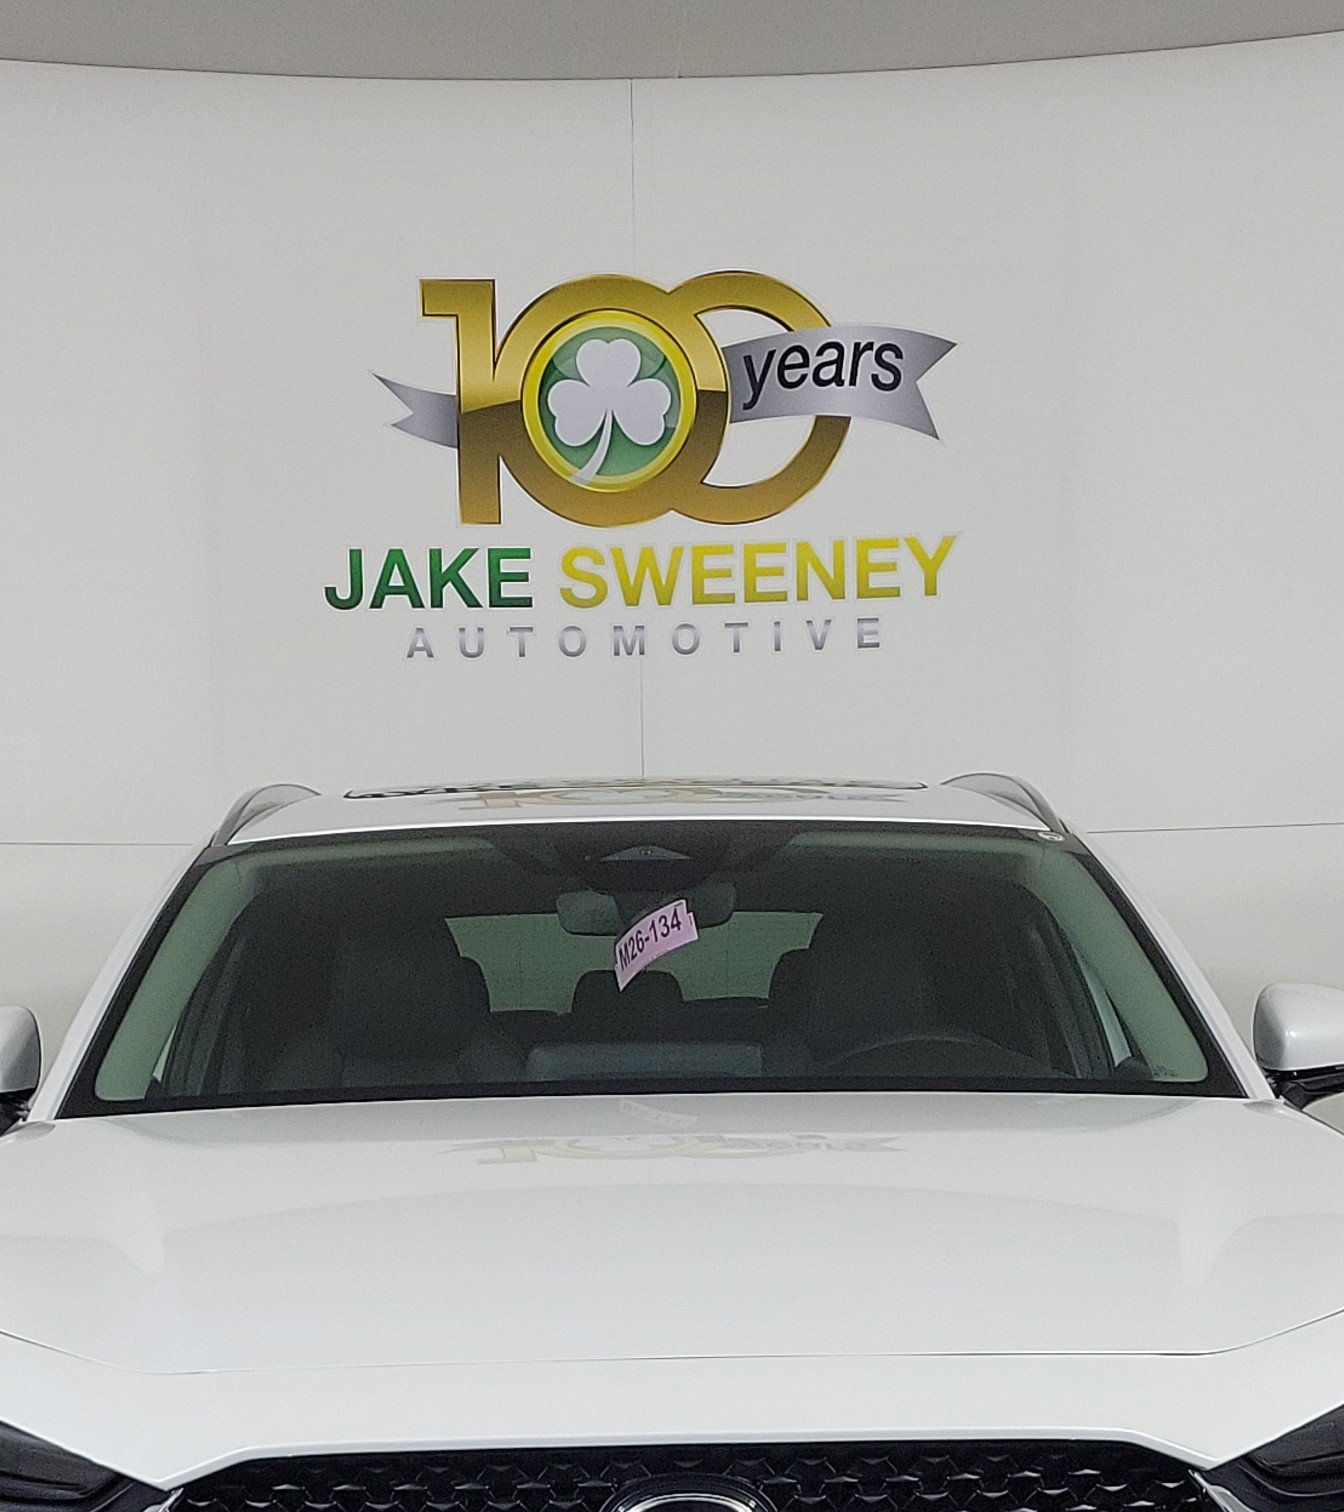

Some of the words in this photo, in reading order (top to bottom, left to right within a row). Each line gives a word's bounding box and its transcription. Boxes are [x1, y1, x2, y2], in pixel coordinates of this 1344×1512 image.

[419, 270, 852, 527] 100
[742, 339, 904, 410] years
[324, 547, 533, 610] JAKE
[559, 535, 957, 608] SWEENEY
[406, 617, 881, 660] AUTOMOTIVE
[618, 908, 682, 971] M26-134
